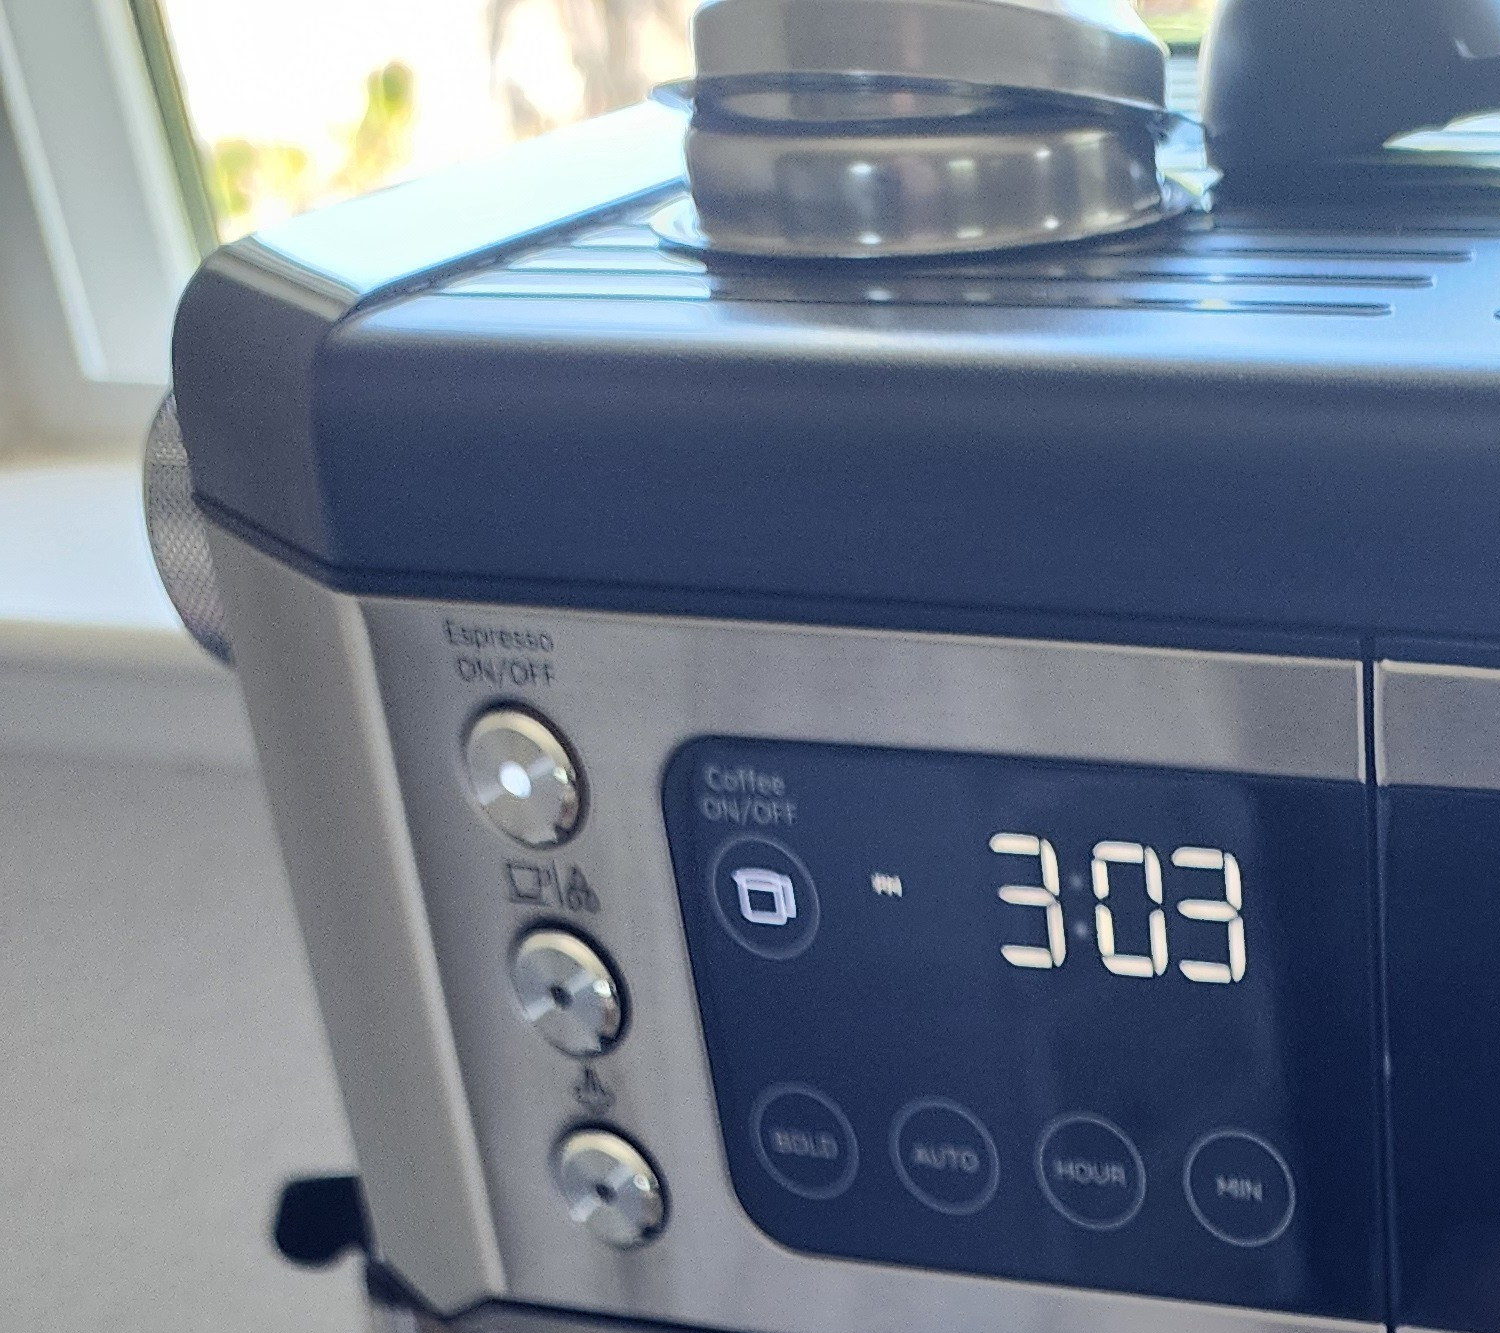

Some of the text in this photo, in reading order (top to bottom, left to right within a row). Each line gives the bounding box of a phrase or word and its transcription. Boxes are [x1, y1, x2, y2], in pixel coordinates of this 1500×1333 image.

[444, 618, 554, 653] Espresso
[456, 657, 556, 687] ON/OFF
[704, 766, 786, 797] Coffee
[702, 797, 797, 825] ON/OFF
[914, 1143, 981, 1173] AUTO
[1055, 1158, 1127, 1188] HOUR
[1216, 1174, 1263, 1202] MIN
